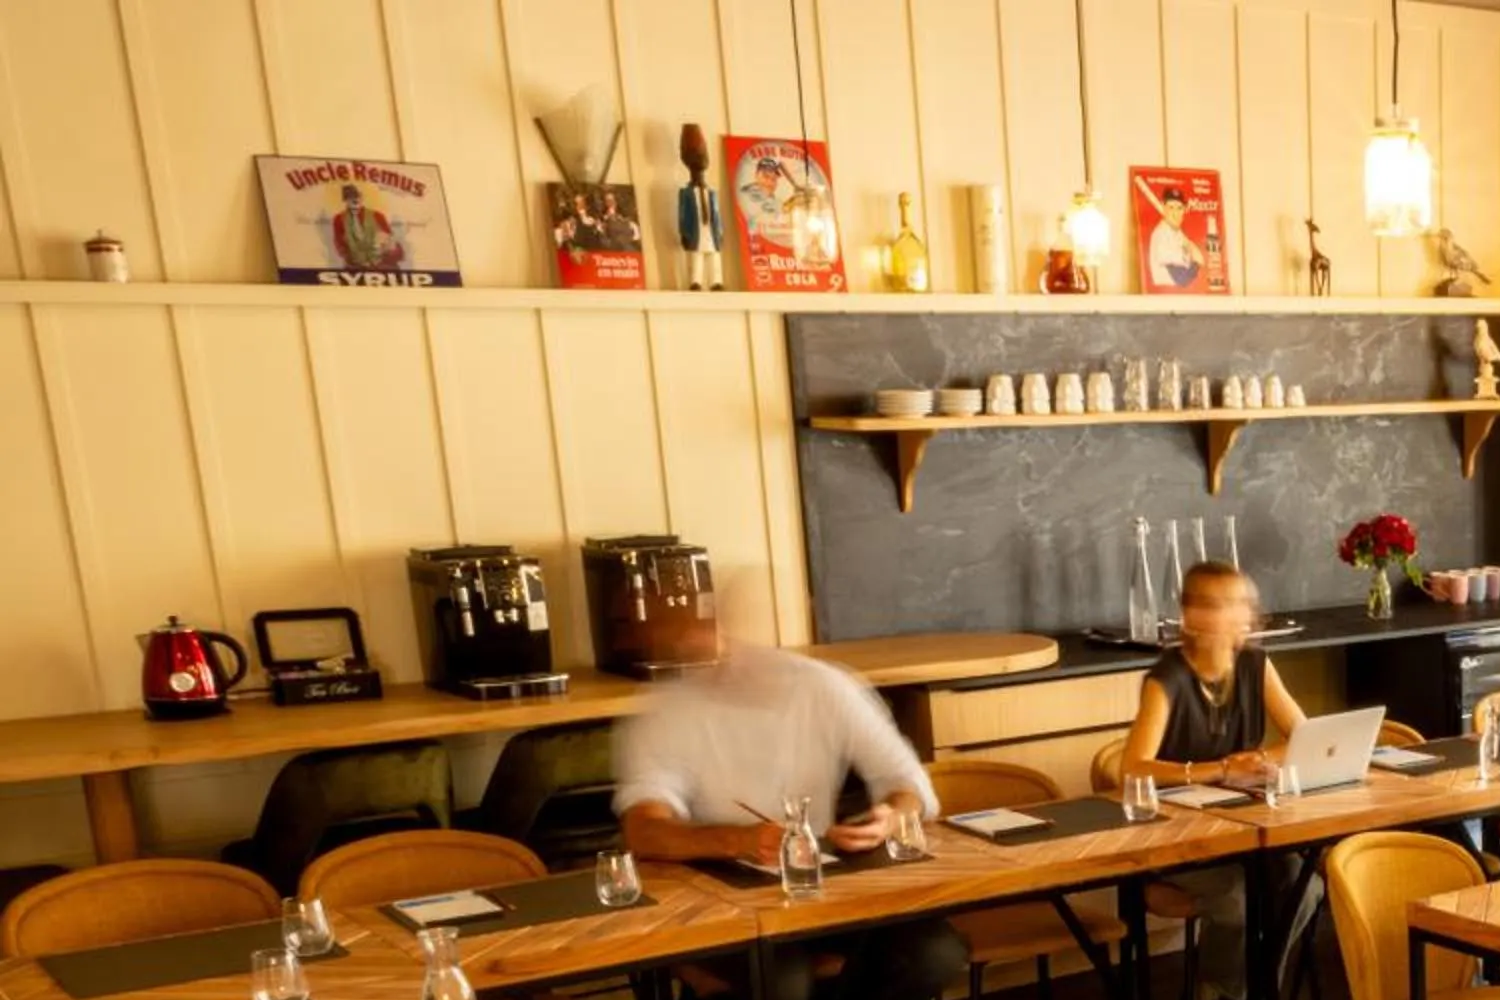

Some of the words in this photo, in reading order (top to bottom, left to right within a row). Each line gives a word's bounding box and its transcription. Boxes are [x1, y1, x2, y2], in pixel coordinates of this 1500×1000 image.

[285, 160, 350, 191] Uncle
[351, 160, 427, 198] Remus
[317, 272, 434, 288] SYRUP
